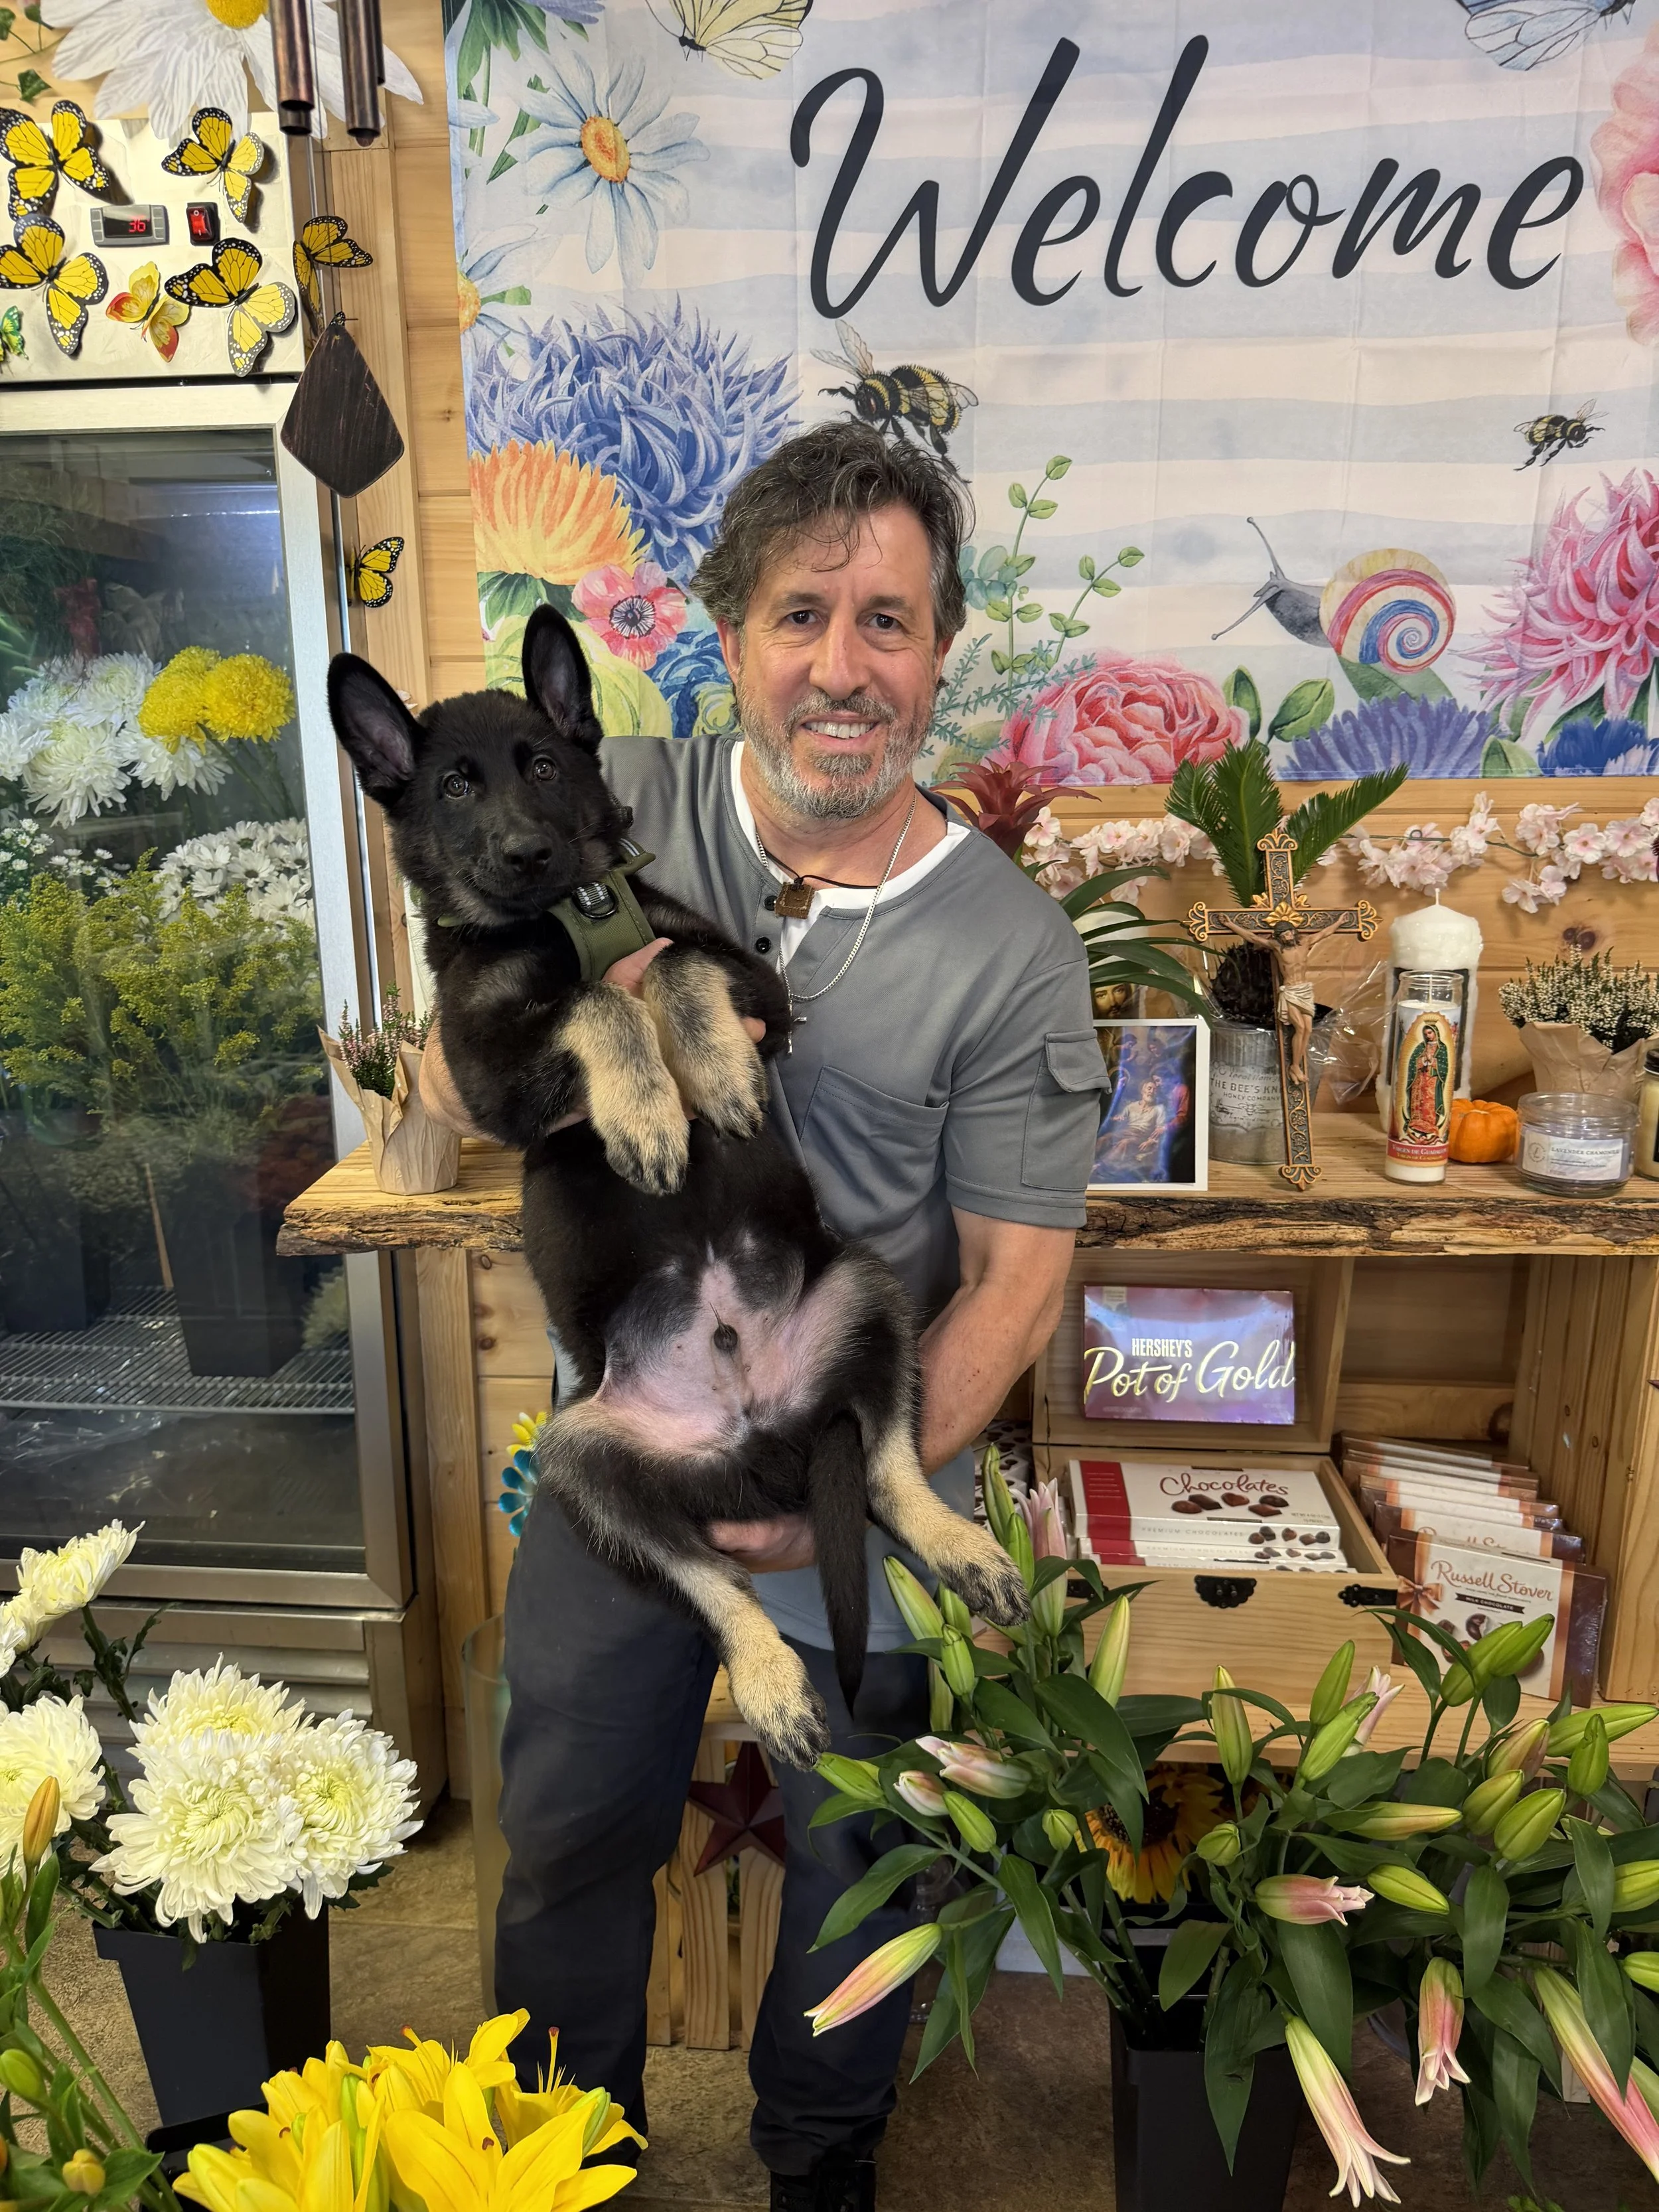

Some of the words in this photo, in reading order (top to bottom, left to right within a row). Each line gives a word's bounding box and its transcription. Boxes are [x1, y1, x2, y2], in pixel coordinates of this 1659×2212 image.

[790, 35, 1585, 319] Welcome
[1210, 1078, 1226, 1089] THE
[1230, 1082, 1260, 1094] BEE'S
[1224, 1092, 1245, 1100] HONEY
[1131, 1337, 1192, 1359] HERSHEY'S
[1084, 1347, 1173, 1405] Pot
[1155, 1363, 1192, 1403] of
[1197, 1339, 1295, 1398] Gold
[1159, 1473, 1289, 1495] Chocolates
[1431, 1560, 1497, 1591] Russell
[1497, 1573, 1553, 1601] Stover
[1480, 1599, 1514, 1610] CHOCOLATE
